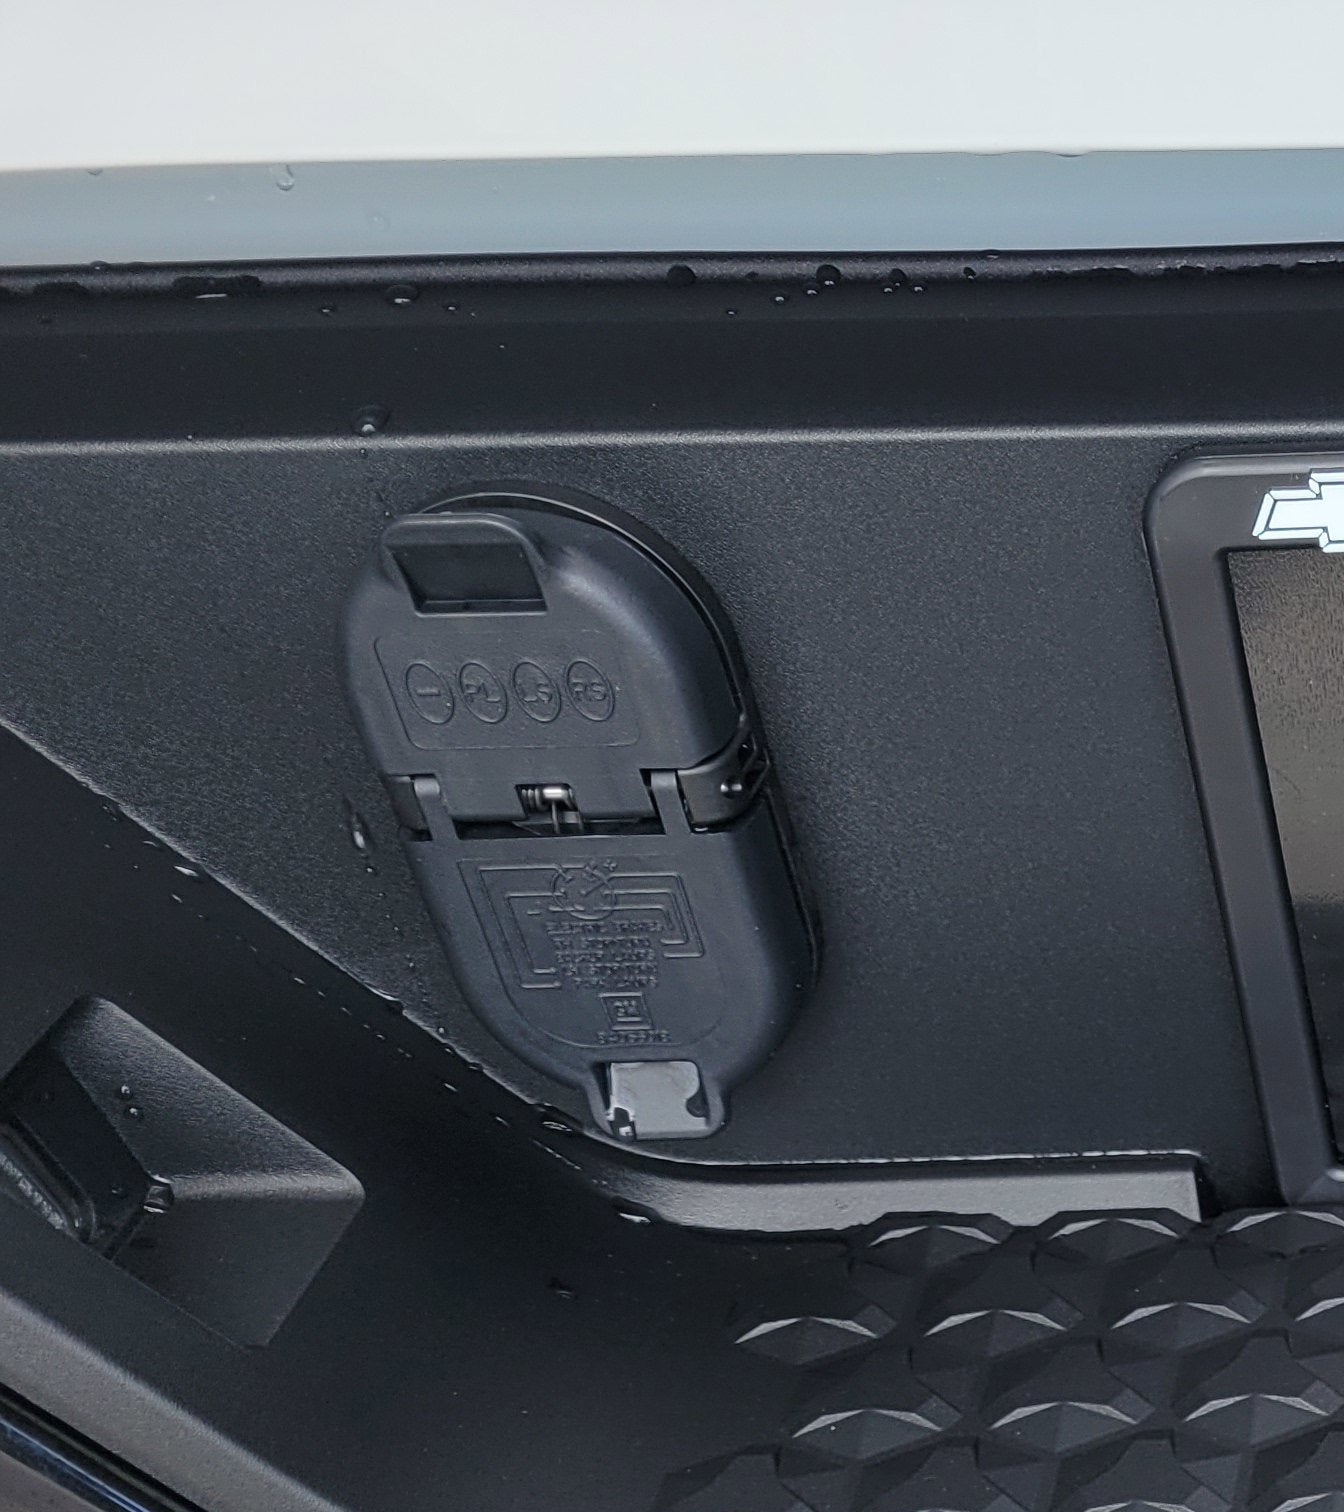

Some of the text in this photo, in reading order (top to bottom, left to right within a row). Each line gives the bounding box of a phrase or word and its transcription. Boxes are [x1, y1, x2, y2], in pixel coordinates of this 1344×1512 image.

[462, 678, 607, 704] PL LS RS
